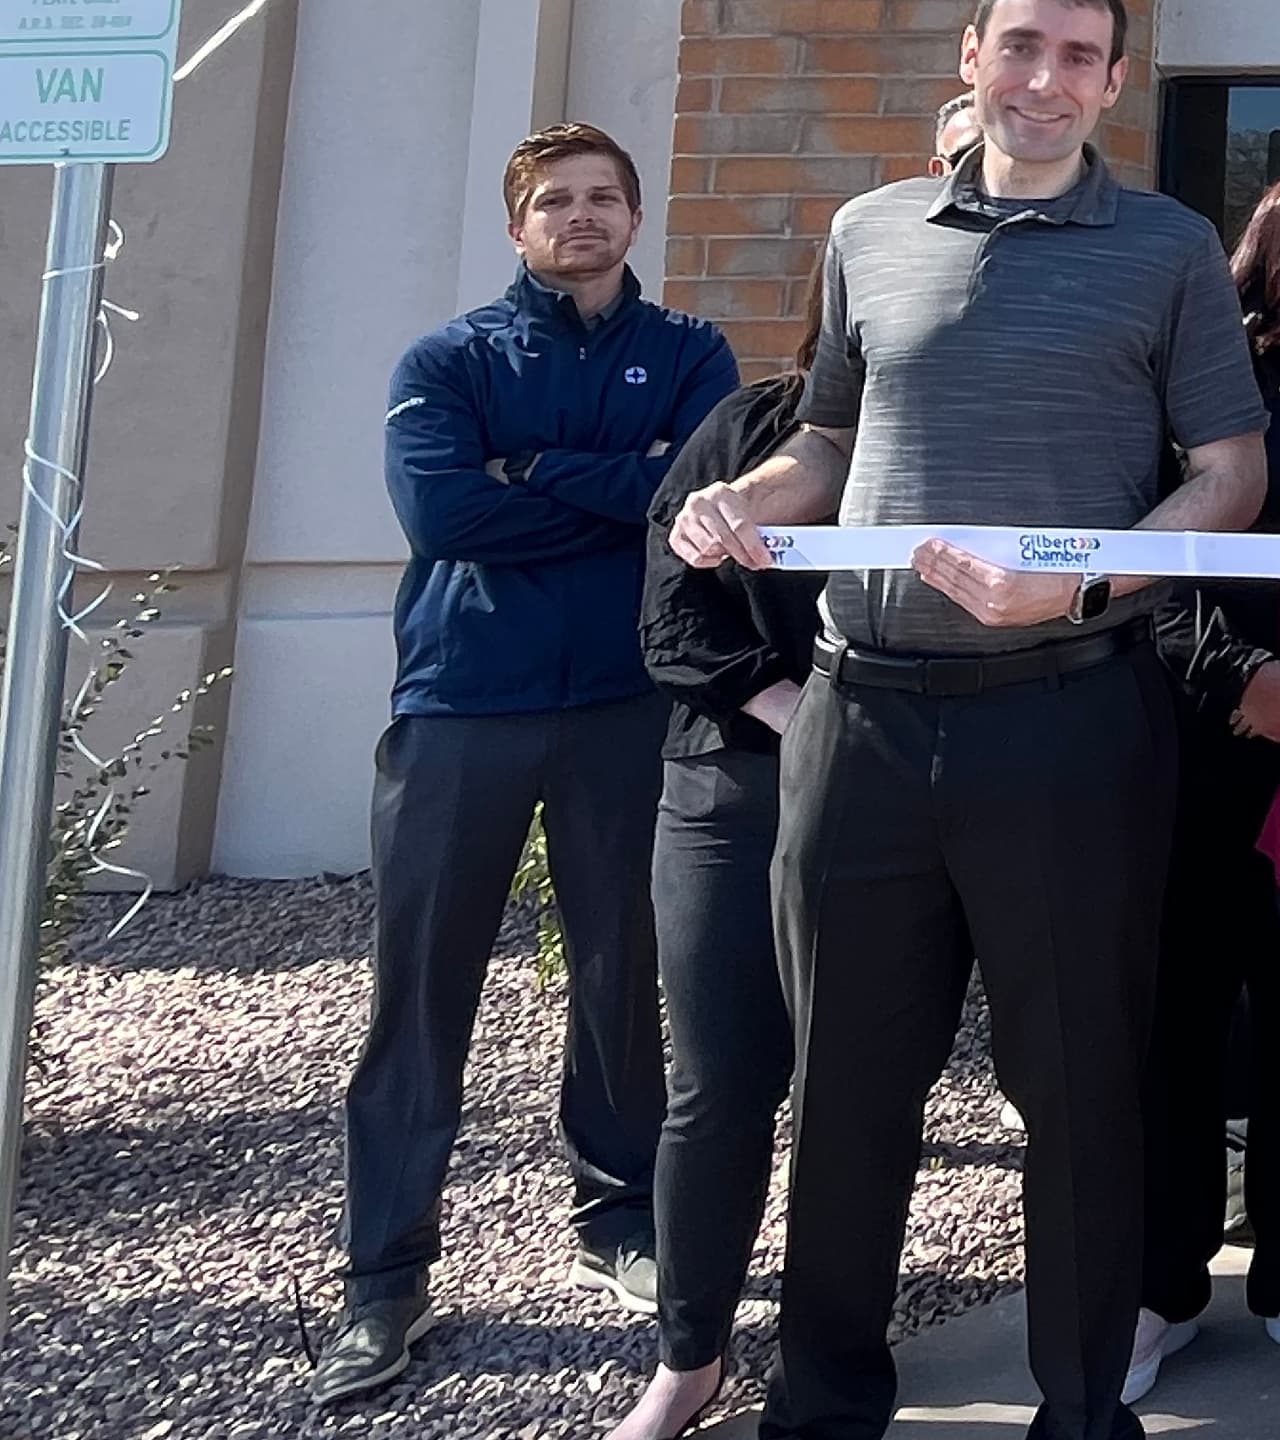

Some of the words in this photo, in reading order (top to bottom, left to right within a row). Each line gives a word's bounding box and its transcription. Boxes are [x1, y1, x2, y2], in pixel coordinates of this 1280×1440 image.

[36, 67, 105, 104] VAN
[0, 118, 131, 143] ACCESSIBLE
[1020, 534, 1077, 550] Gilbert
[1021, 547, 1091, 562] Chamber
